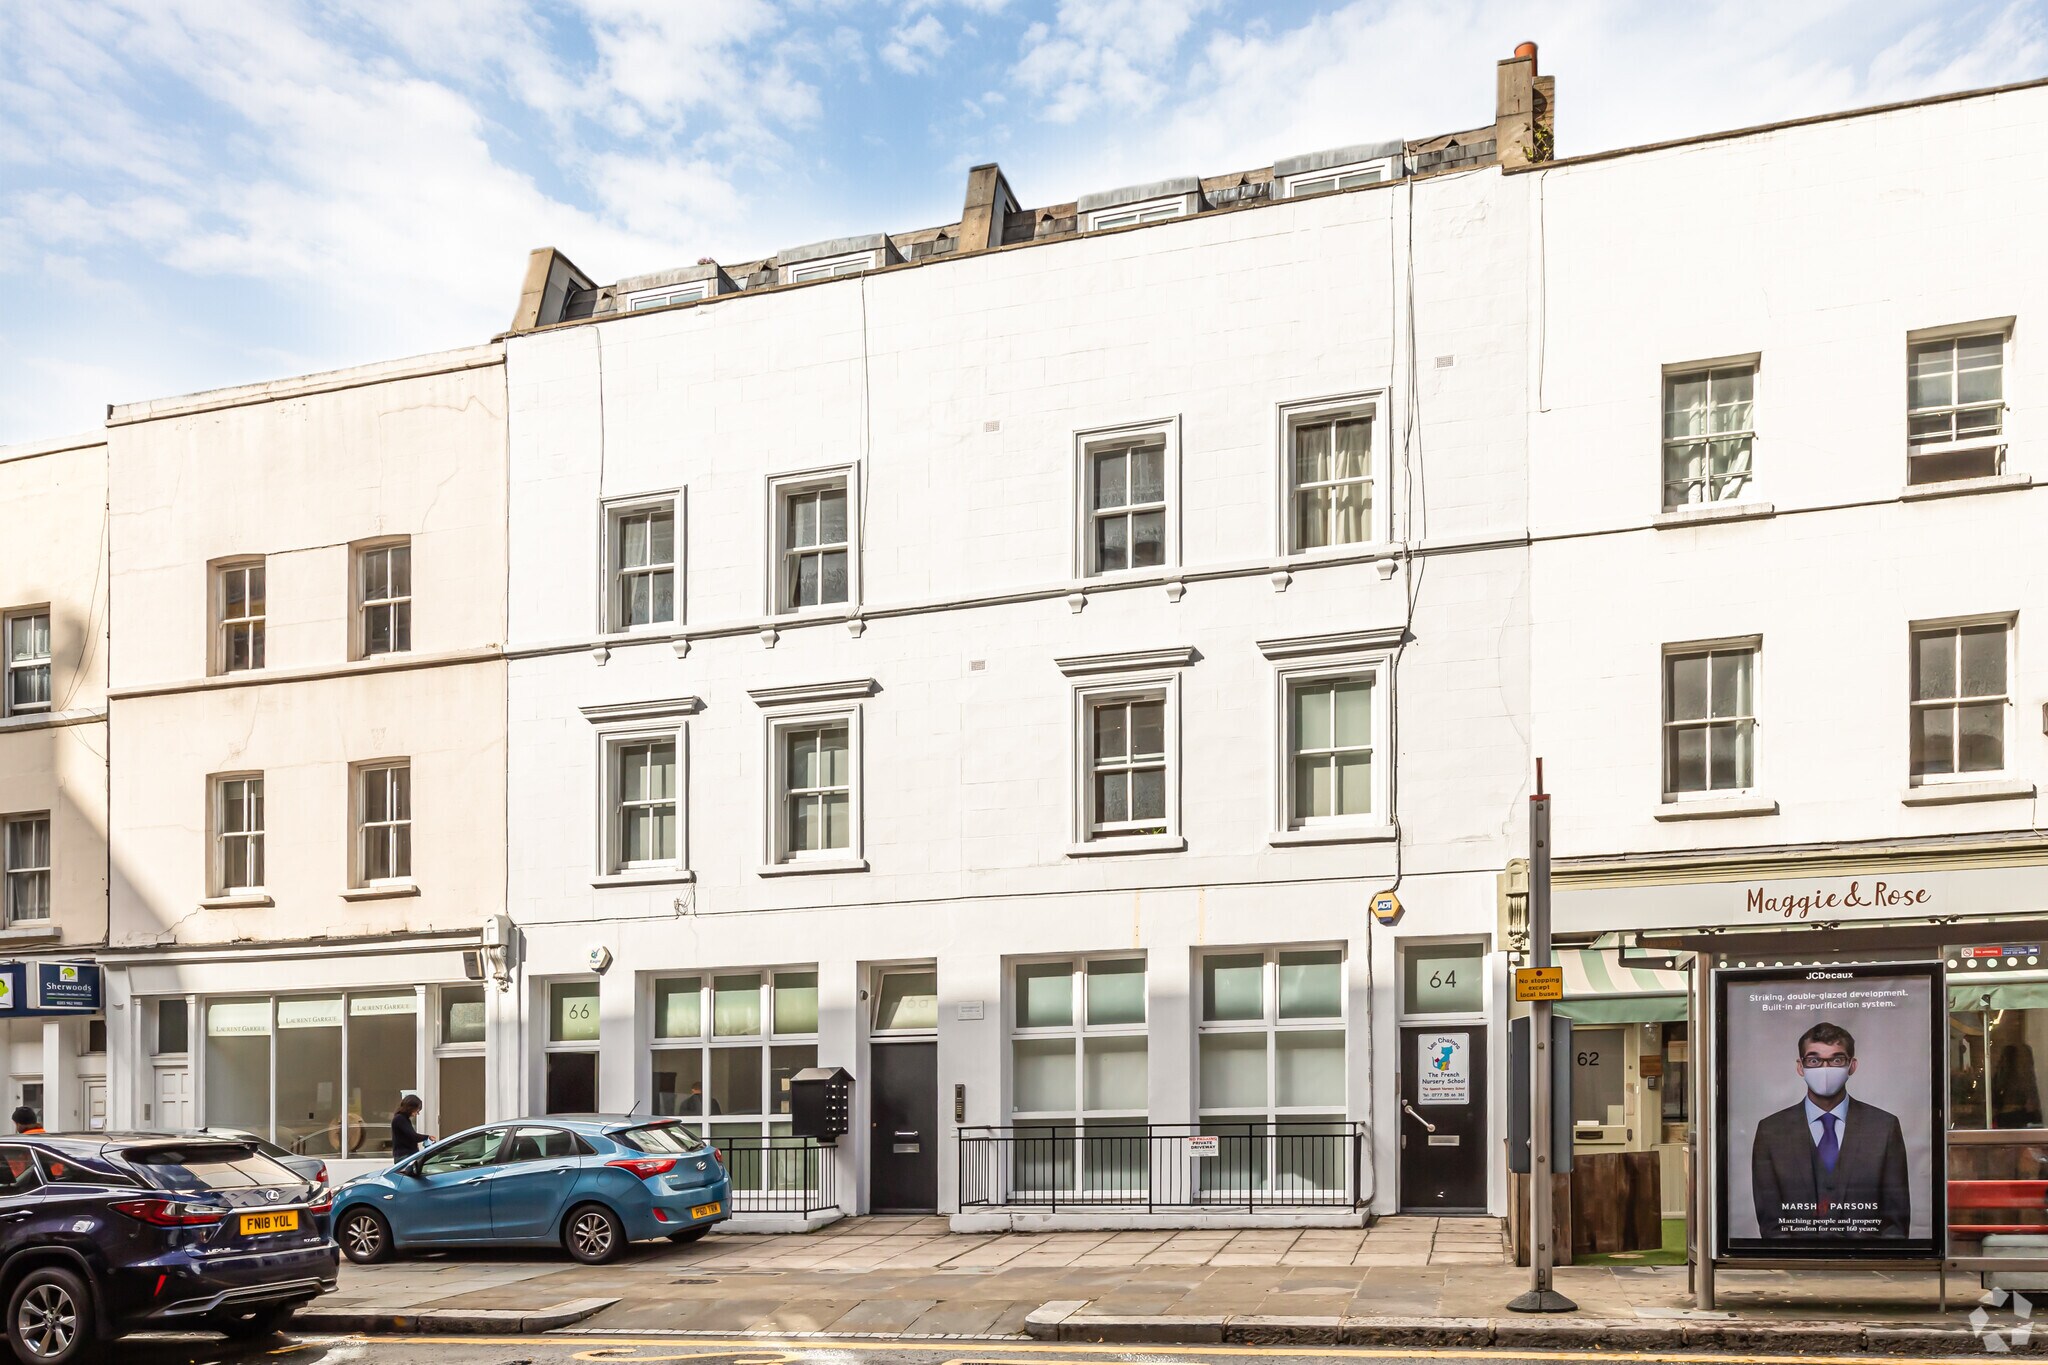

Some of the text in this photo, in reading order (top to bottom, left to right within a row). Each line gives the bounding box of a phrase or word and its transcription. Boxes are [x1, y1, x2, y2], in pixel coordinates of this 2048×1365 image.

[1378, 901, 1391, 909] ADT
[1747, 881, 1932, 918] Maggie & Rose
[1429, 970, 1457, 989] 64
[1531, 977, 1560, 985] stopping
[1806, 972, 1854, 980] JCDecaux
[46, 982, 92, 991] Sherwoods
[1749, 989, 1909, 1002] Striking, double-glazed development.
[569, 1003, 589, 1019] 66
[1762, 1000, 1896, 1011] Built-in air-purification system.
[1427, 1037, 1460, 1051] Les Chatons
[1577, 1052, 1600, 1066] 62
[1830, 1202, 1878, 1210] PARSONS
[247, 1217, 271, 1230] FN18
